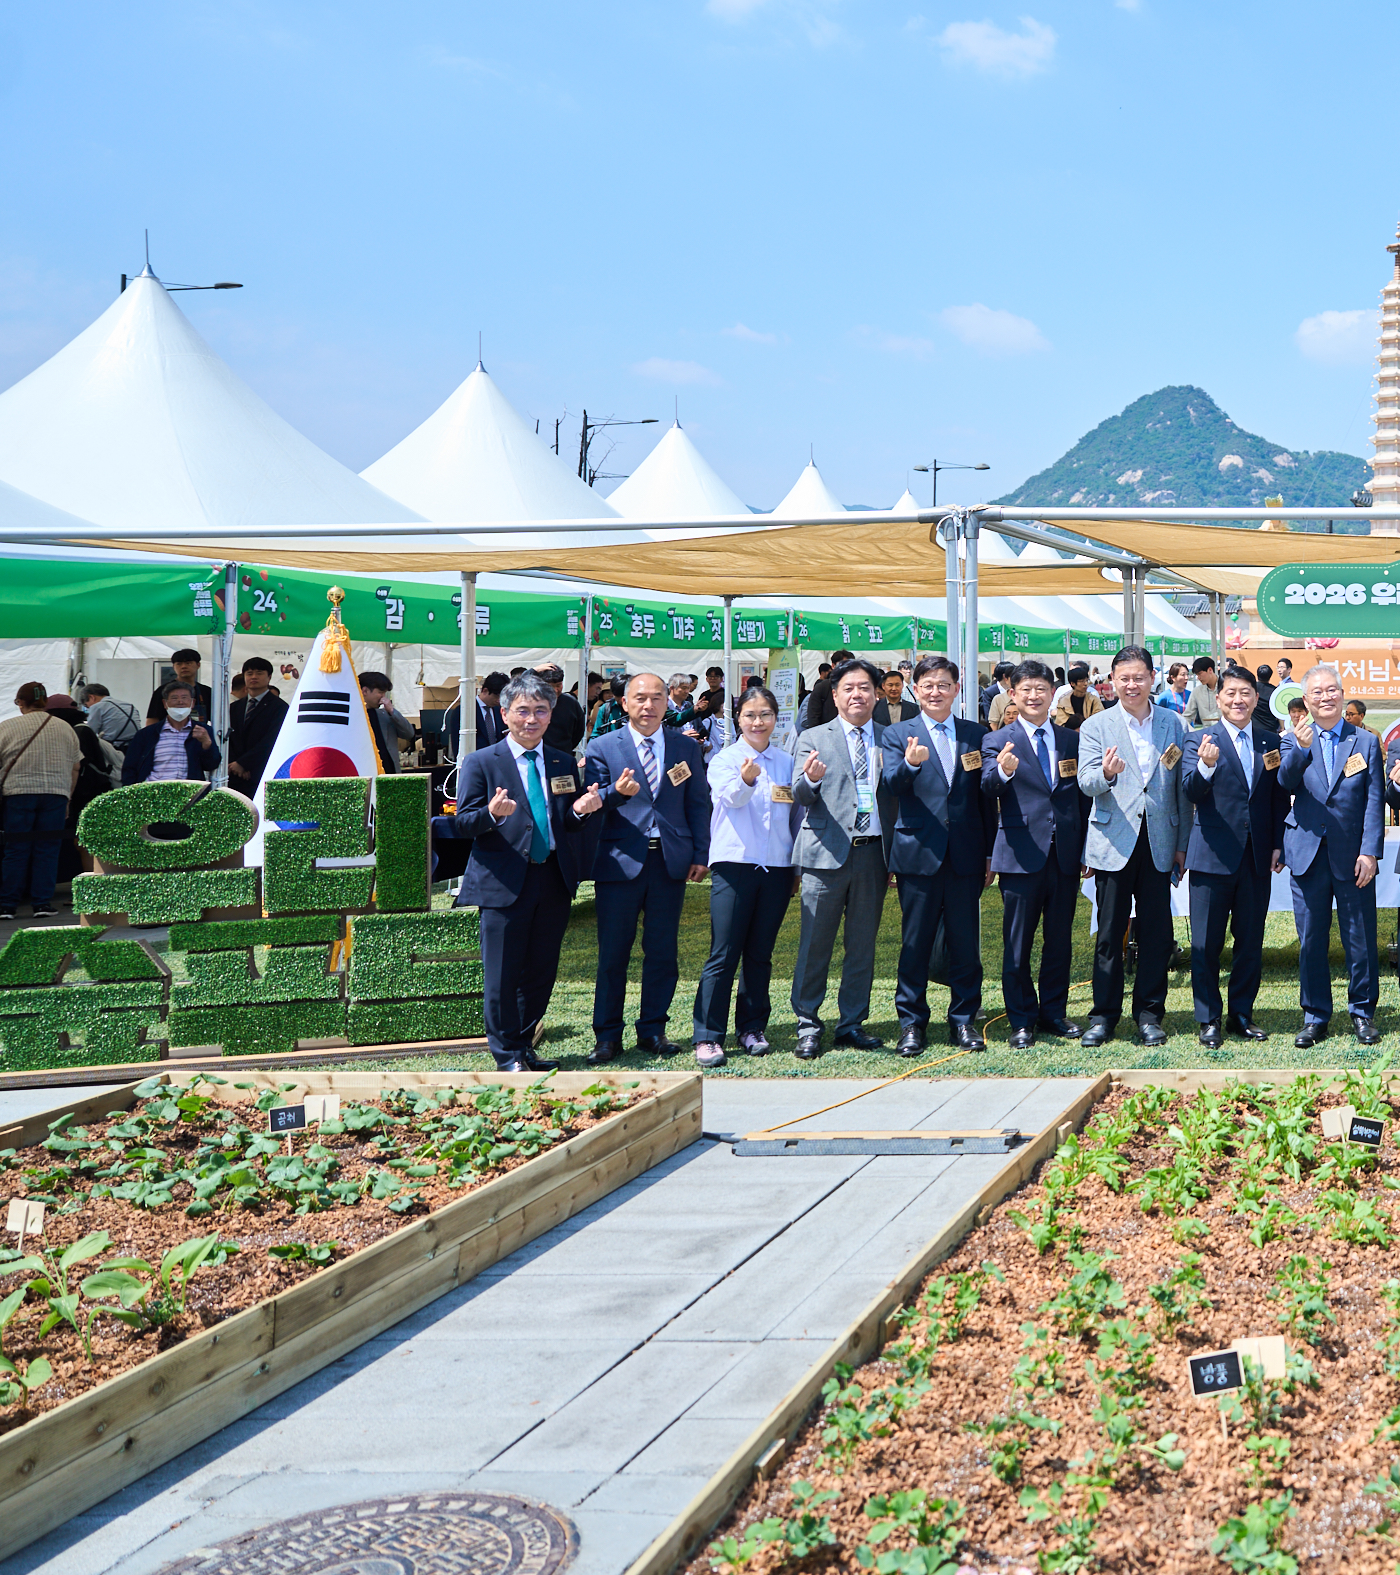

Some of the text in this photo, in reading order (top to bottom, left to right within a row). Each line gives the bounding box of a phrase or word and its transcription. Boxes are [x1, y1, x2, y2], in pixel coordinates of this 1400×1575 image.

[253, 589, 278, 612] 24
[1284, 582, 1367, 606] 2026
[385, 598, 405, 630] 감
[600, 613, 613, 630] 25
[630, 613, 655, 639] 호두
[672, 616, 695, 640] 대추
[736, 620, 766, 643] 산딸기
[798, 624, 808, 638] 26
[1349, 686, 1385, 695] 유네스코
[72, 773, 431, 925] 우리
[277, 1111, 296, 1127] 곰취
[1199, 1362, 1232, 1386] 방풍
